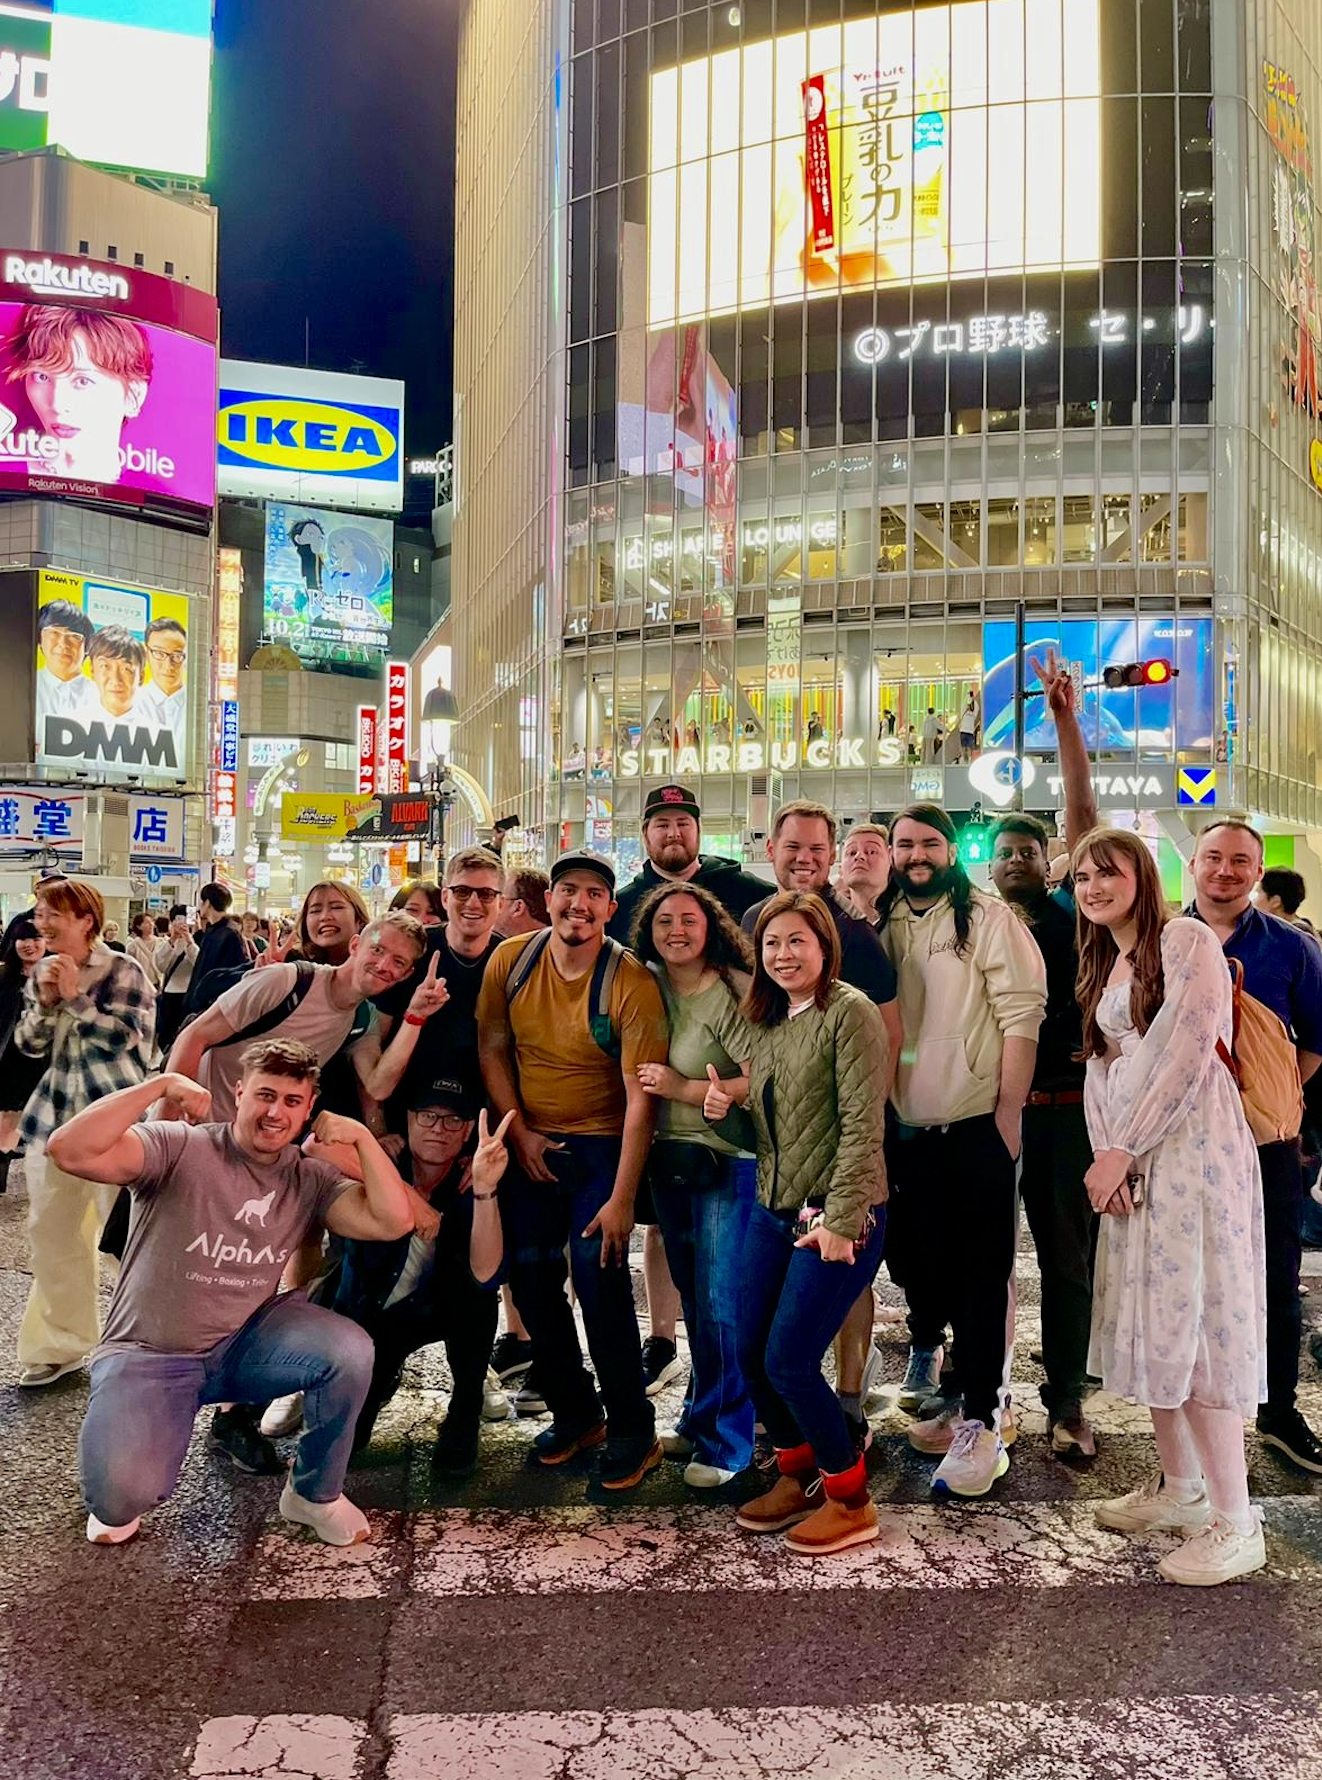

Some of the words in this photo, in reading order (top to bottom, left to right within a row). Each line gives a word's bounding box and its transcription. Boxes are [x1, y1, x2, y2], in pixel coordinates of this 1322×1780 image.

[858, 81, 904, 227] 豆乳の力
[5, 256, 129, 299] Rakuten
[894, 312, 1049, 359] プロ野球
[228, 413, 383, 457] IKEA
[28, 478, 69, 491] Rakuten
[69, 482, 99, 495] Vision
[745, 519, 838, 547] LOUNGE
[390, 674, 405, 750] カラオケ
[44, 715, 179, 768] DMM
[620, 737, 901, 776] STARBUCKS
[1046, 776, 1162, 796] TTAYA
[133, 808, 168, 843] 店
